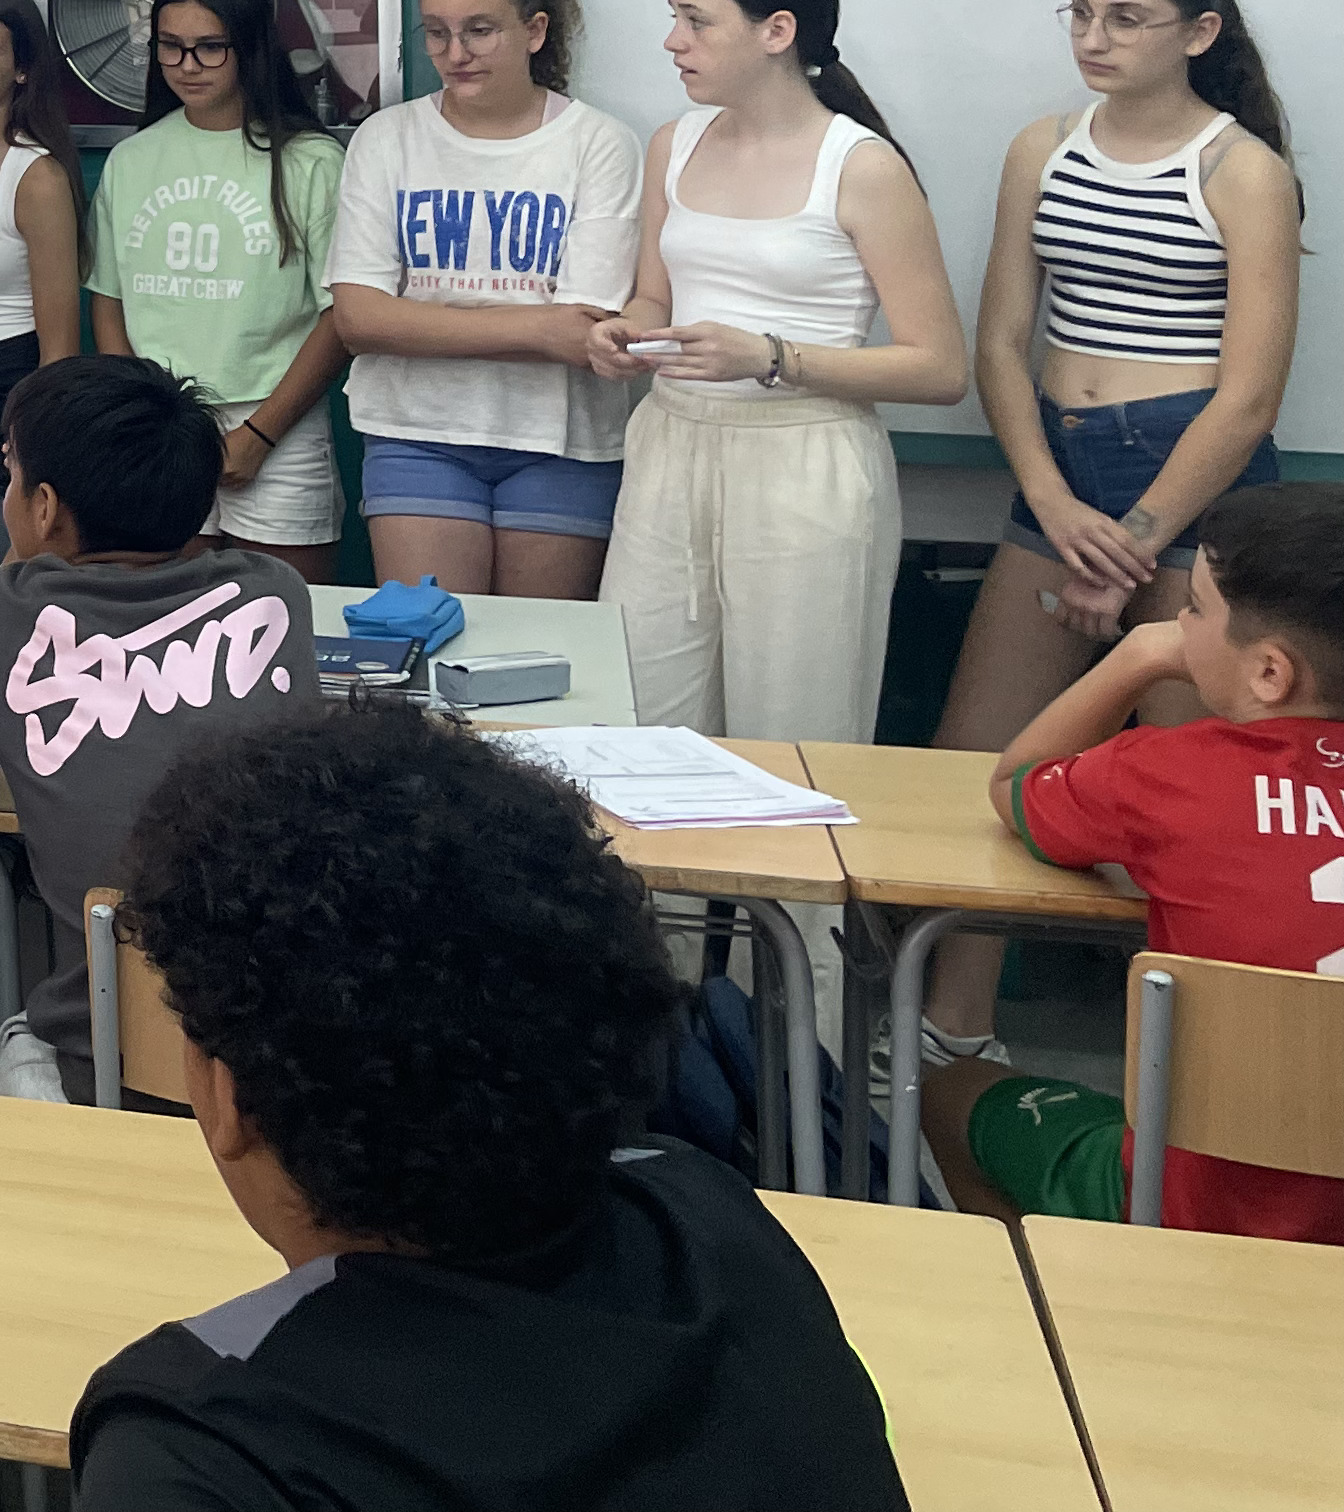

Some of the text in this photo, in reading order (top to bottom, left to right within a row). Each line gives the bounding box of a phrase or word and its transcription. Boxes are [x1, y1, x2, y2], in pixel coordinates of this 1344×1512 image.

[124, 174, 273, 256] DETROIT RULES
[483, 190, 567, 277] YOR
[165, 221, 220, 273] 80
[133, 273, 245, 300] GREAT CREW
[412, 275, 441, 289] CITY
[449, 276, 484, 291] THAT
[491, 277, 535, 292] NEVER
[1254, 774, 1344, 838] HA
